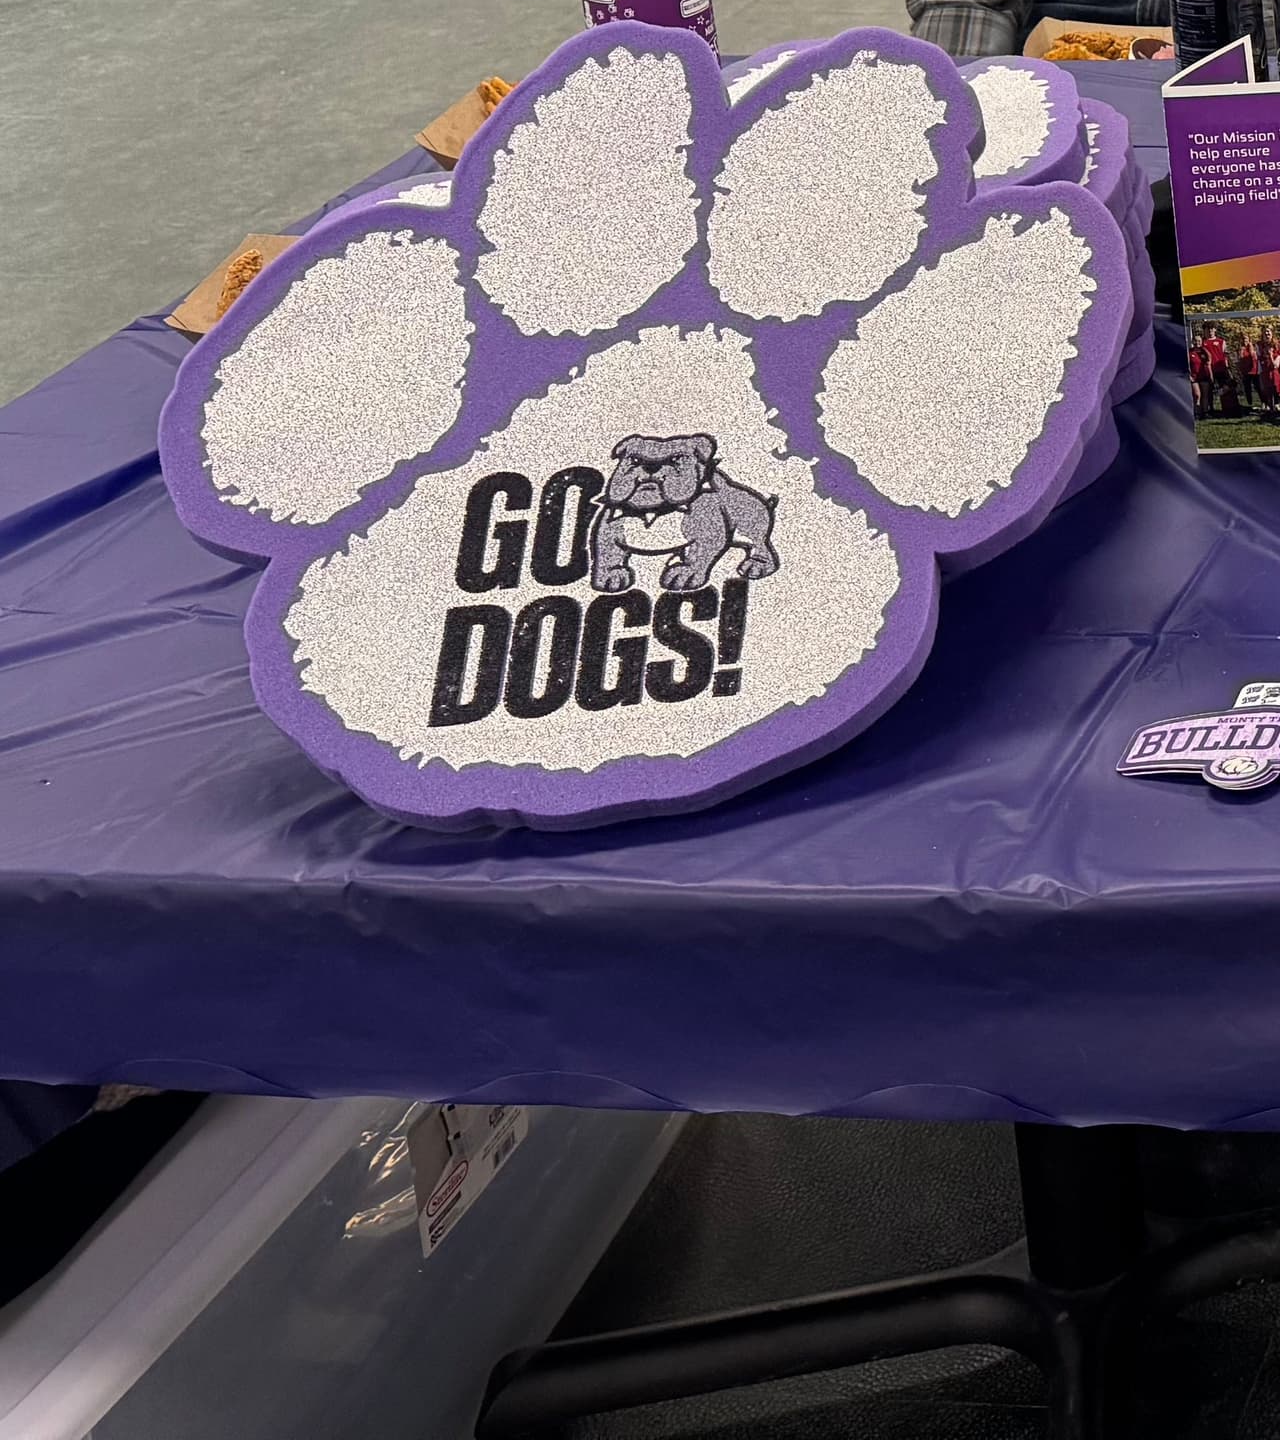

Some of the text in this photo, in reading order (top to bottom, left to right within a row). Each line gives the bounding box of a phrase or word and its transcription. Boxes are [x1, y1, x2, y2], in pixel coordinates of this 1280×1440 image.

[1188, 133, 1219, 145] "Our
[1223, 130, 1275, 144] Mission
[1190, 147, 1270, 161] help ensure
[1191, 162, 1256, 176] everyone
[1193, 178, 1240, 190] chance
[1244, 177, 1261, 187] on
[1265, 177, 1273, 186] a
[1194, 191, 1245, 206] playing
[455, 465, 606, 594] GO
[427, 578, 749, 728] DOGS!
[1216, 715, 1267, 724] MONTY
